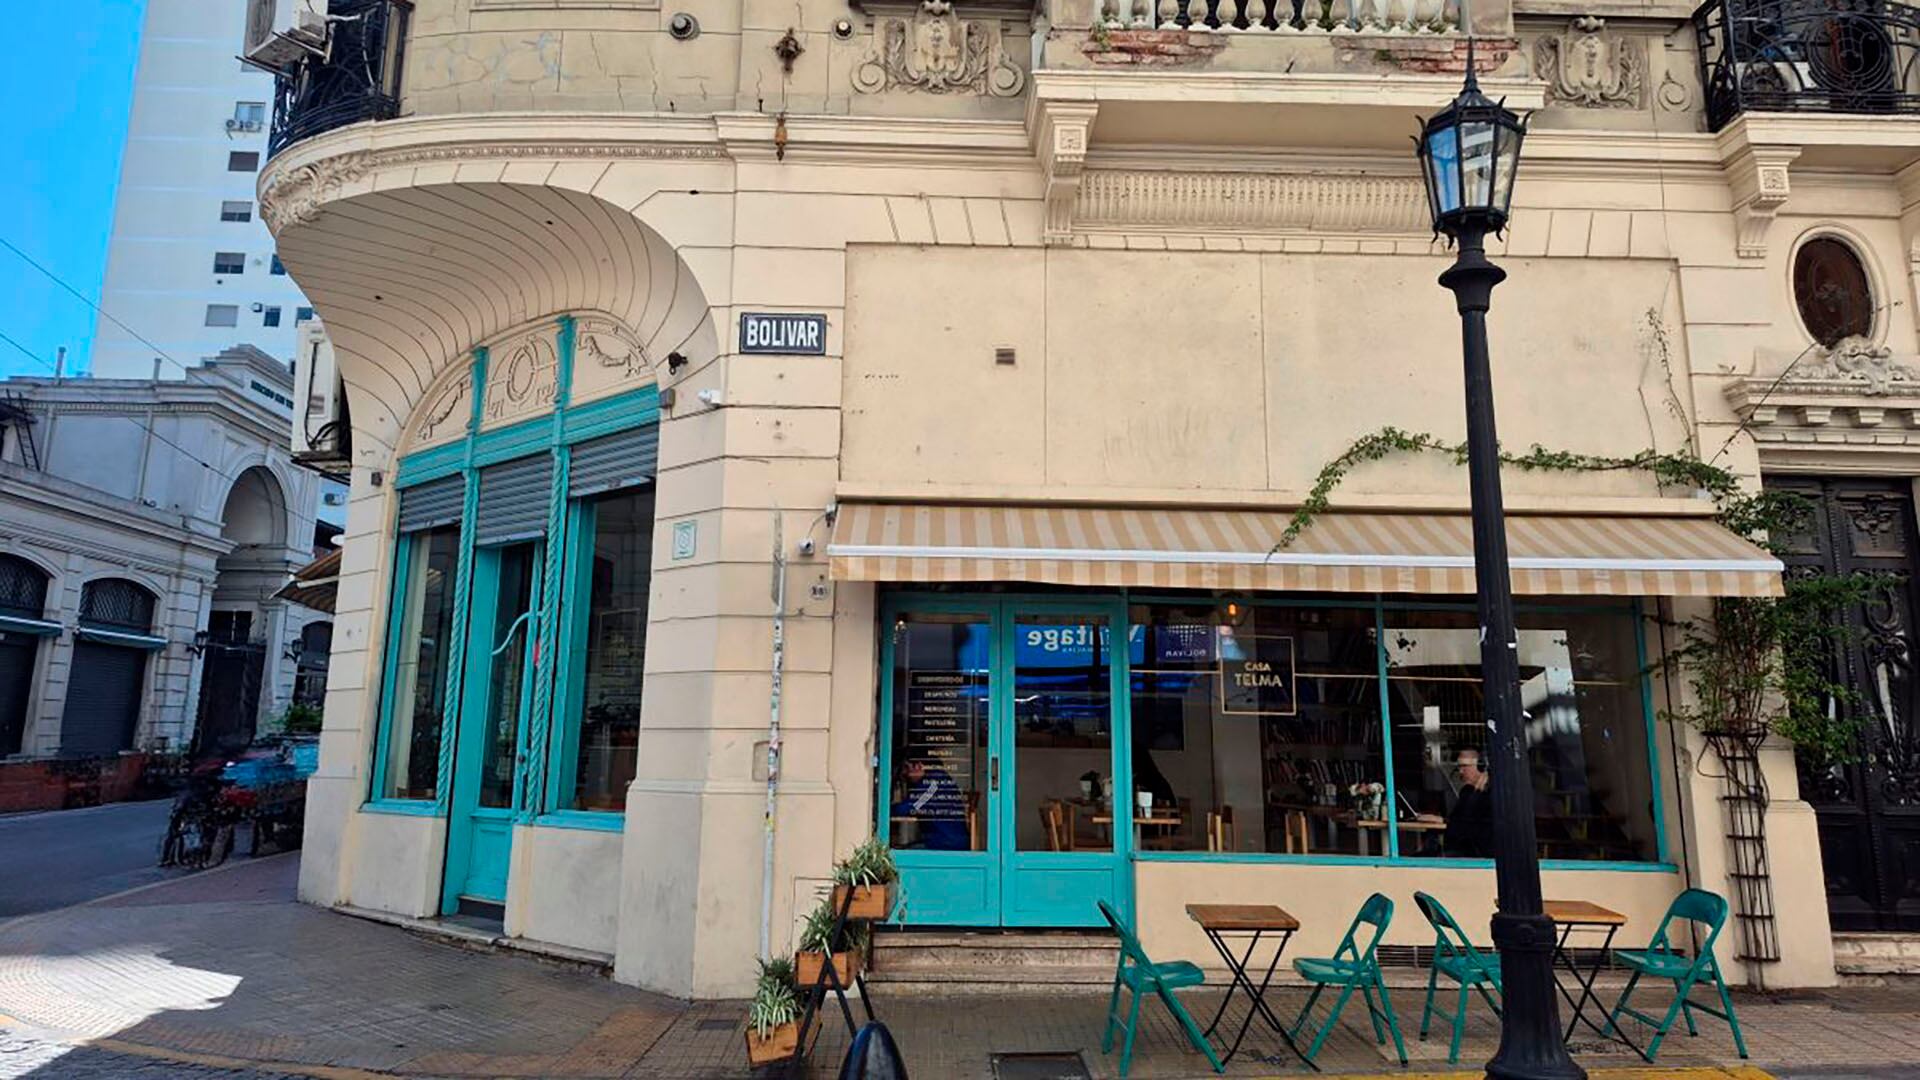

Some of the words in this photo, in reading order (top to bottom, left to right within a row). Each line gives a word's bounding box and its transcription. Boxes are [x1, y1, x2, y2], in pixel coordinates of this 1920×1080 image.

[747, 320, 818, 347] BOLIVAR
[1244, 662, 1271, 671] CASA
[1235, 673, 1283, 687] TELMA
